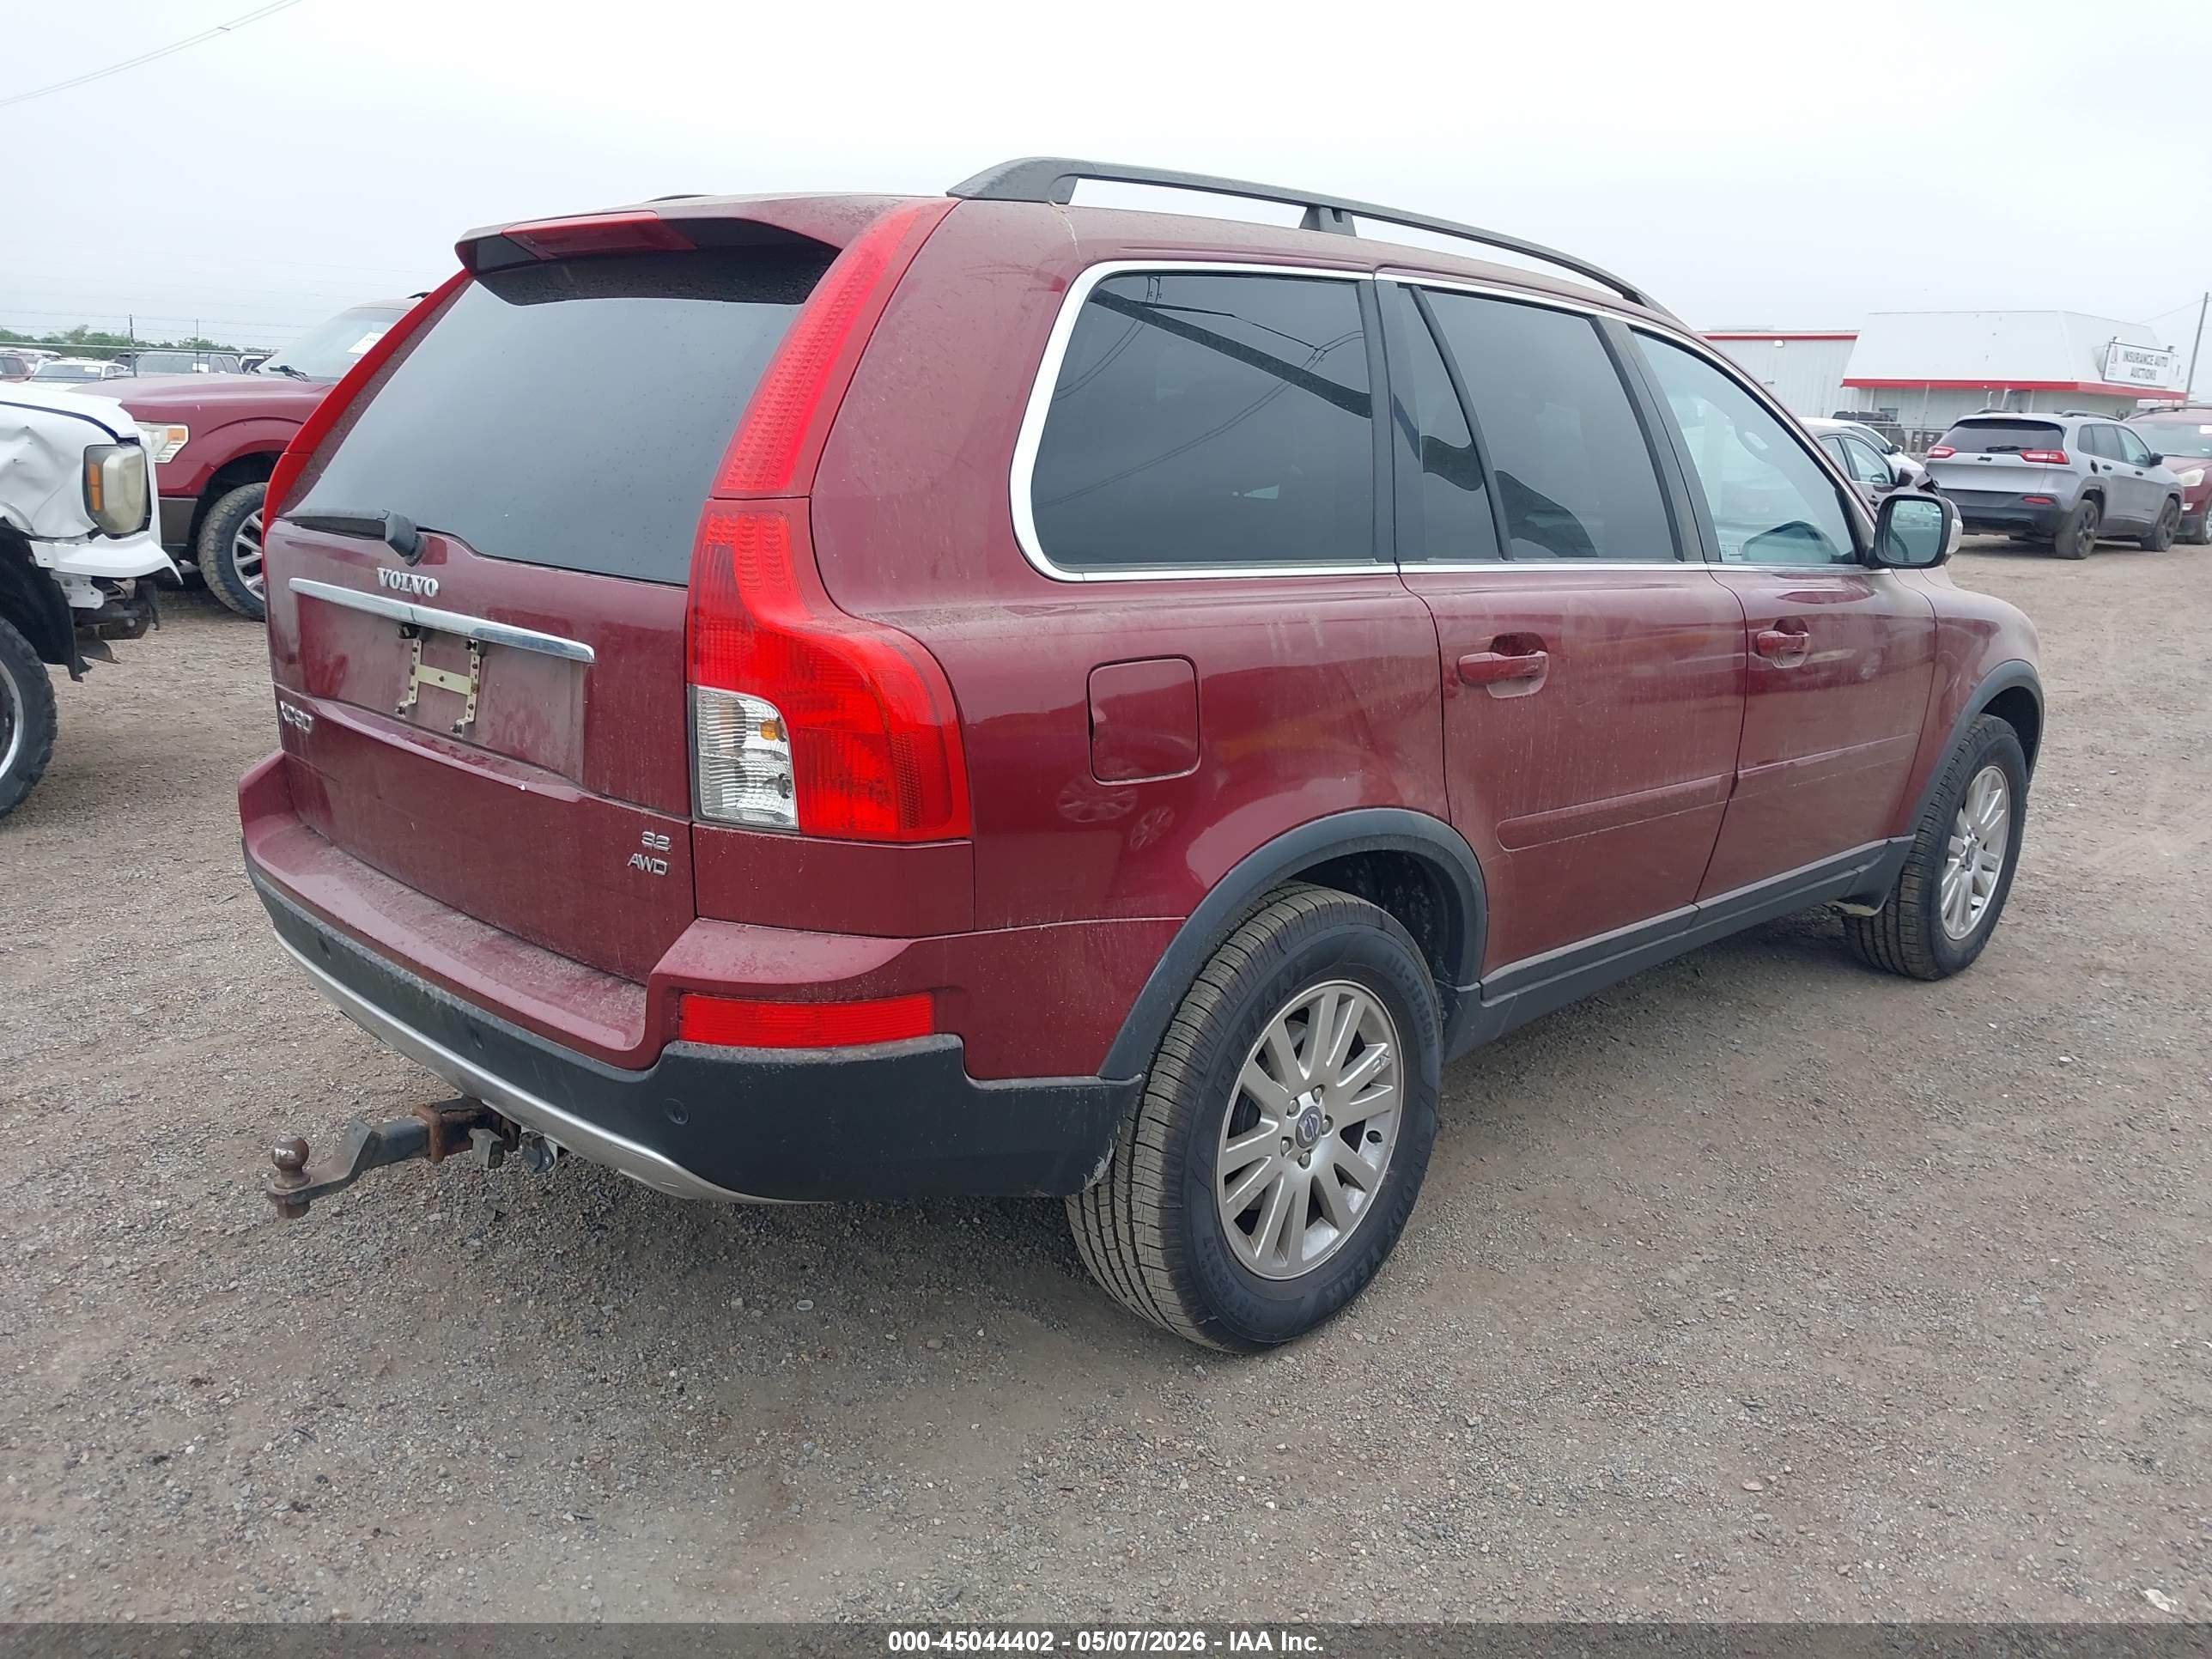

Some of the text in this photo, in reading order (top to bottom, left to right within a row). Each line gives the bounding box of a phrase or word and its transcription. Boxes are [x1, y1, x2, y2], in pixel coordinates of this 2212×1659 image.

[2123, 349, 2154, 366] INSURANCE
[2130, 366, 2157, 380] AUCTIONS
[377, 567, 440, 597] VOLVO
[627, 853, 668, 876] AWD
